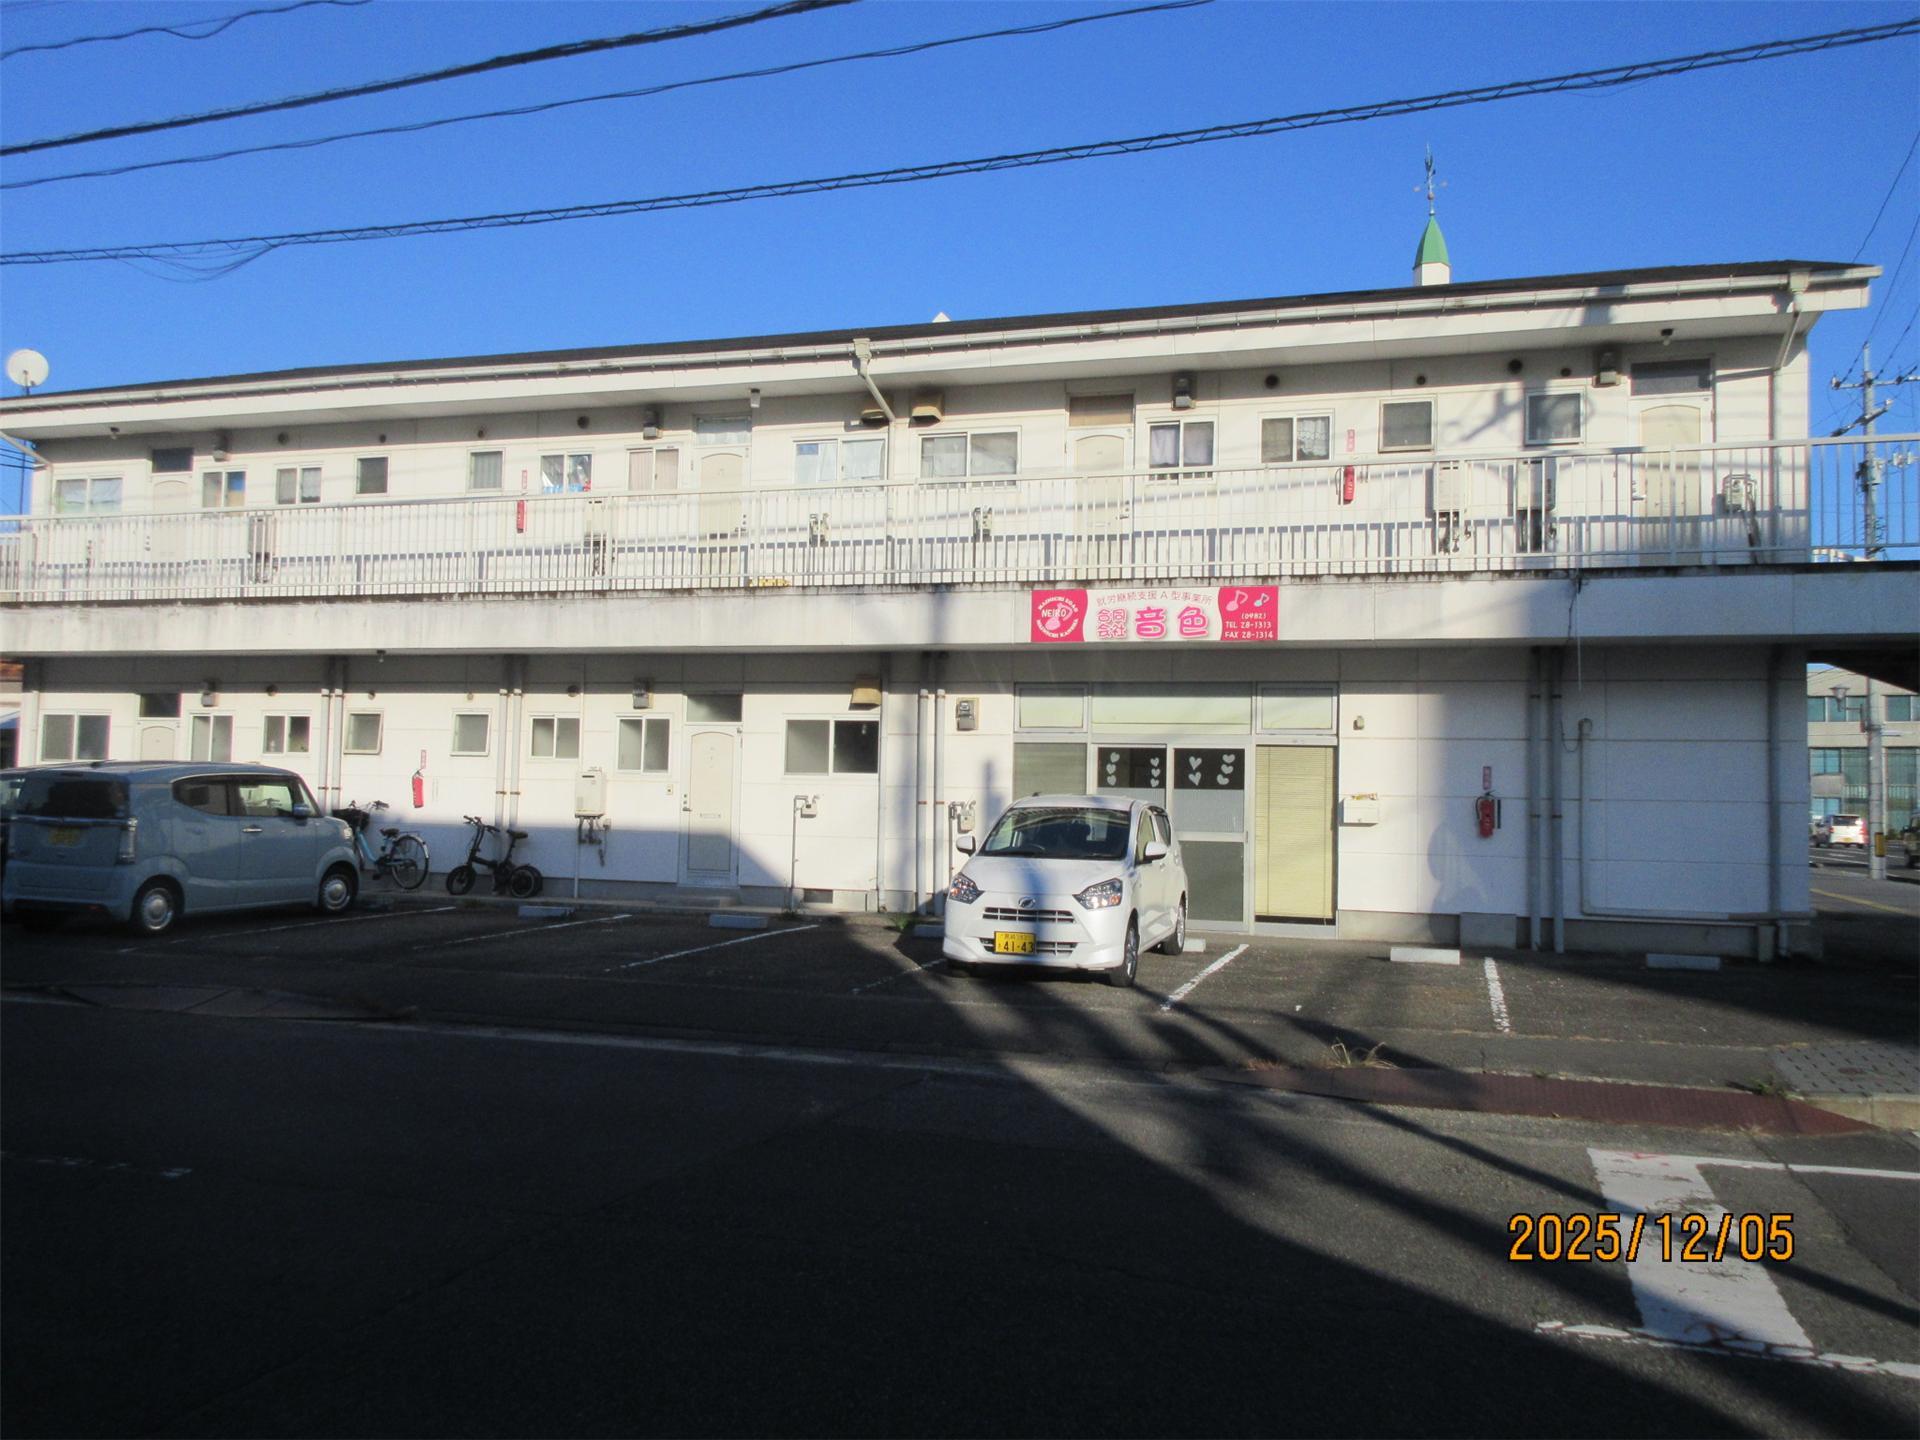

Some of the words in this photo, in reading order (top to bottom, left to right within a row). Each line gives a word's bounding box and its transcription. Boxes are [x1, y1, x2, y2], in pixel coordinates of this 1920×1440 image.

[1041, 608, 1066, 618] NEIRO
[1135, 606, 1208, 638] 音色
[1225, 621, 1238, 629] TEL
[1240, 621, 1272, 629] 28-1313
[1225, 631, 1239, 639] FAX
[1241, 630, 1274, 639] 28-1314
